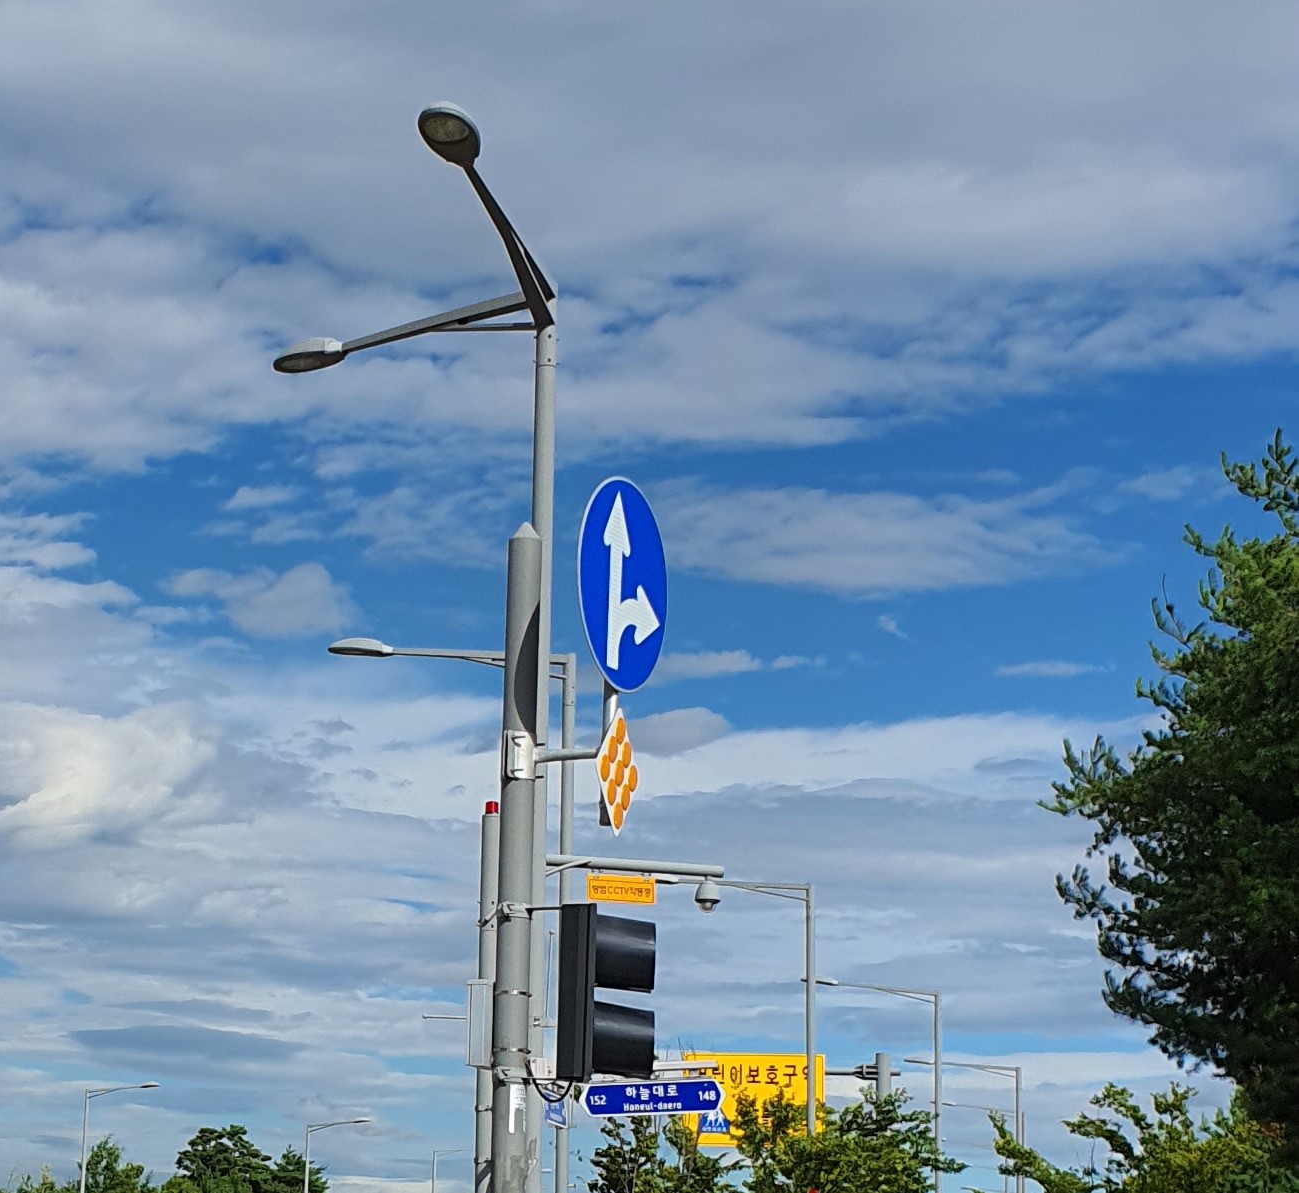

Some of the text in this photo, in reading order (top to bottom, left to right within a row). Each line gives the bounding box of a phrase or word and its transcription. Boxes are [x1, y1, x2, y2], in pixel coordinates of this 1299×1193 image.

[589, 1084, 717, 1106] 152 하늘대로 148
